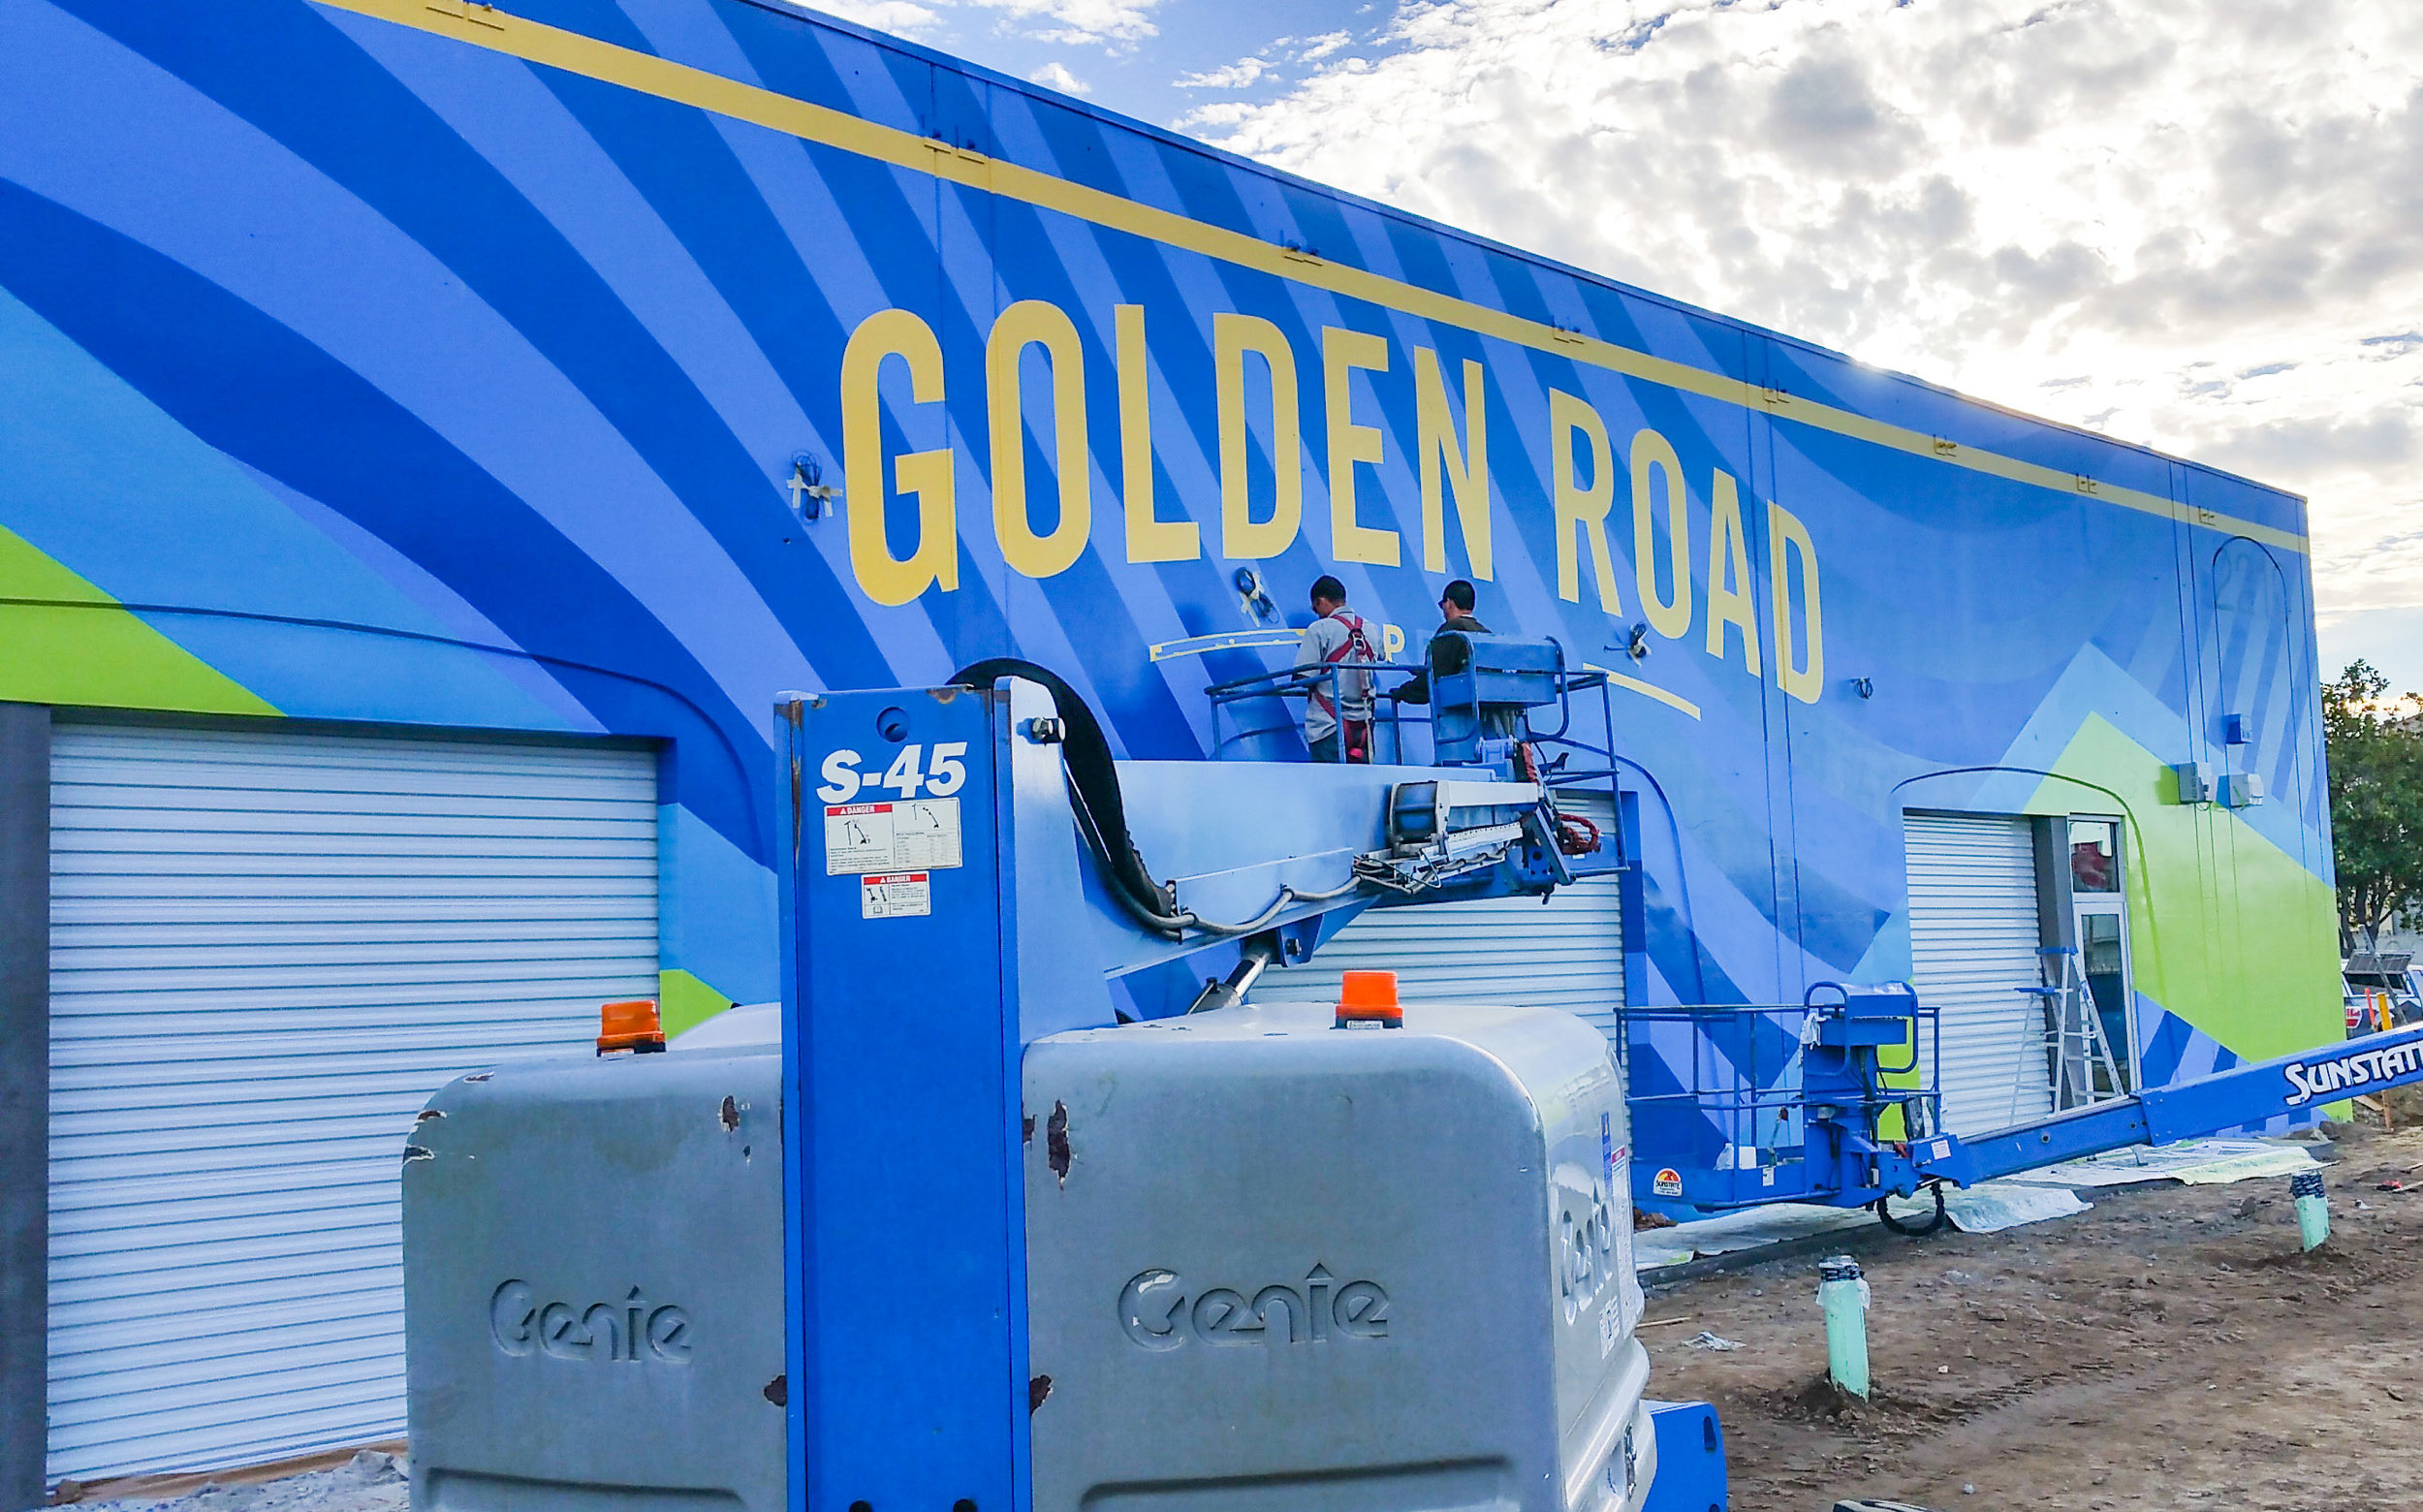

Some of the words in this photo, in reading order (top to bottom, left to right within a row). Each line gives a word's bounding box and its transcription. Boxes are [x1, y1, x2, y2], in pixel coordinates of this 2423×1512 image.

[841, 300, 1494, 607] GOLDEN
[1549, 388, 1824, 705] ROAD
[816, 740, 967, 804] S-45
[846, 805, 875, 815] DANGER
[2284, 1040, 2423, 1106] SUNSTAT
[489, 1275, 693, 1365] Genie
[1117, 1262, 1390, 1353] Genie
